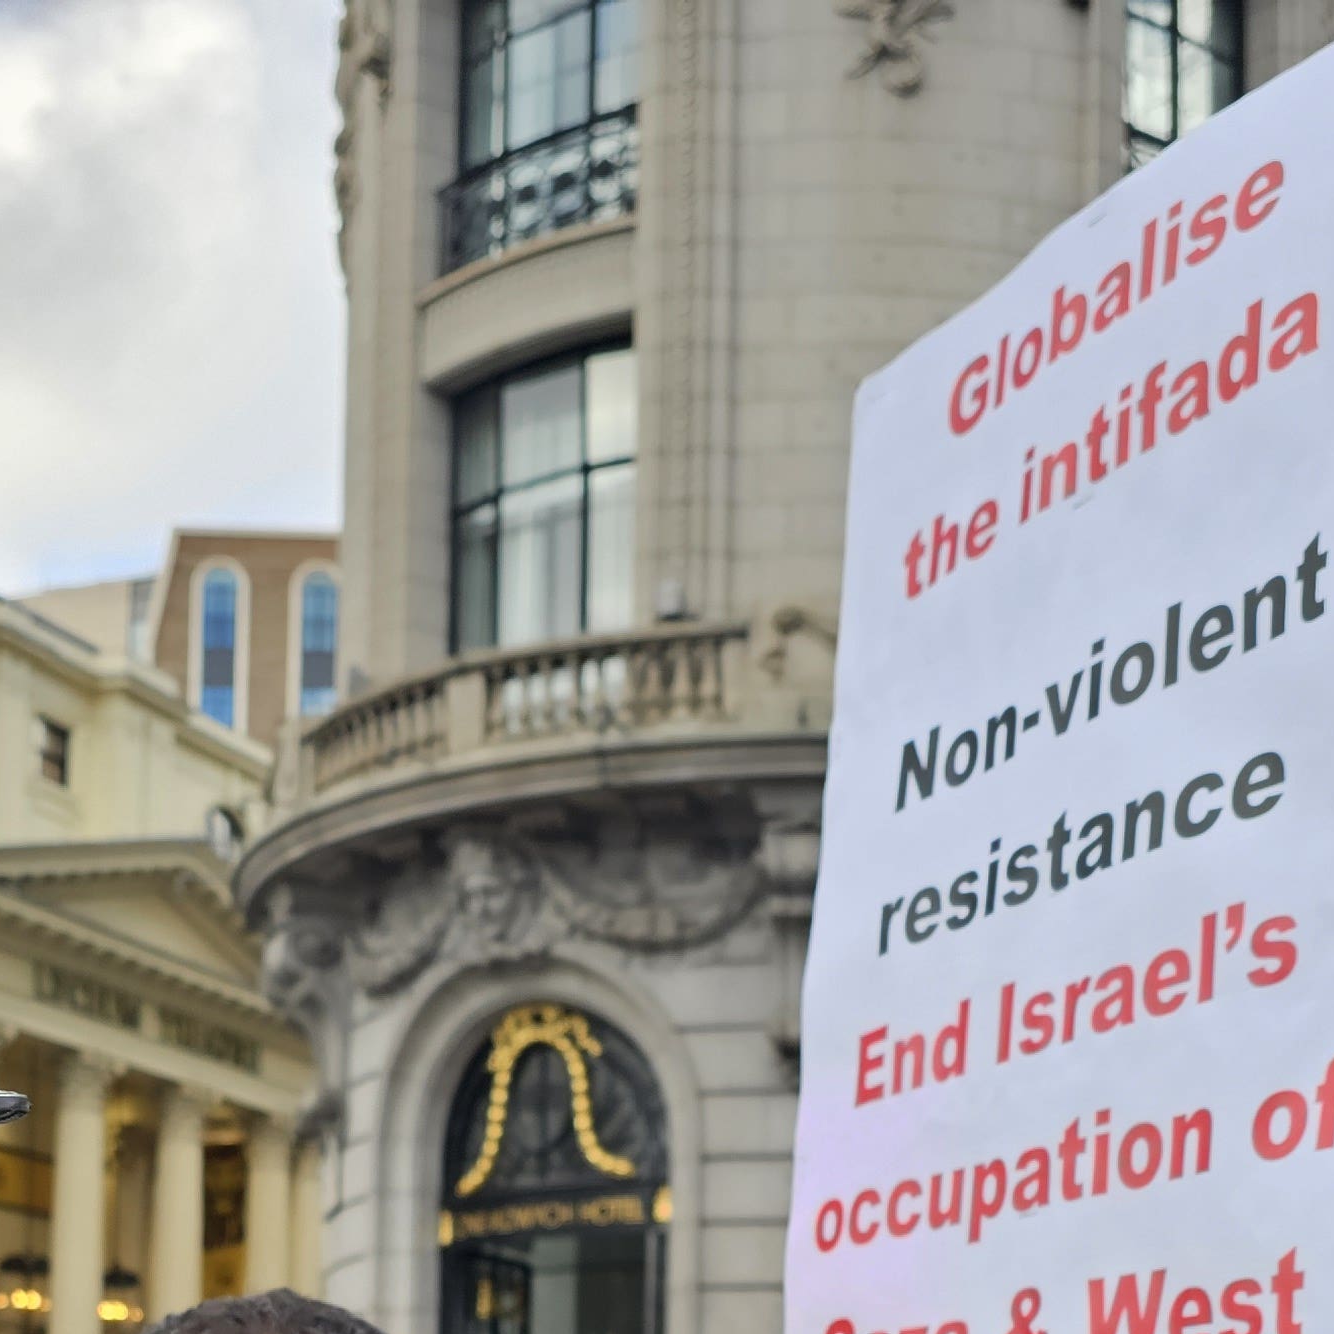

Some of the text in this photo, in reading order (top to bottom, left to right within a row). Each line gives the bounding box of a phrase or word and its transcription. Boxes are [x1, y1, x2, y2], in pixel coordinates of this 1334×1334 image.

[948, 160, 1284, 436] Globalise
[903, 292, 1320, 599] the intifada
[895, 533, 1328, 813] Non-violent
[879, 751, 1286, 955] resistance
[854, 902, 1298, 1107] End Israel’s
[815, 1107, 1213, 1251] occupation
